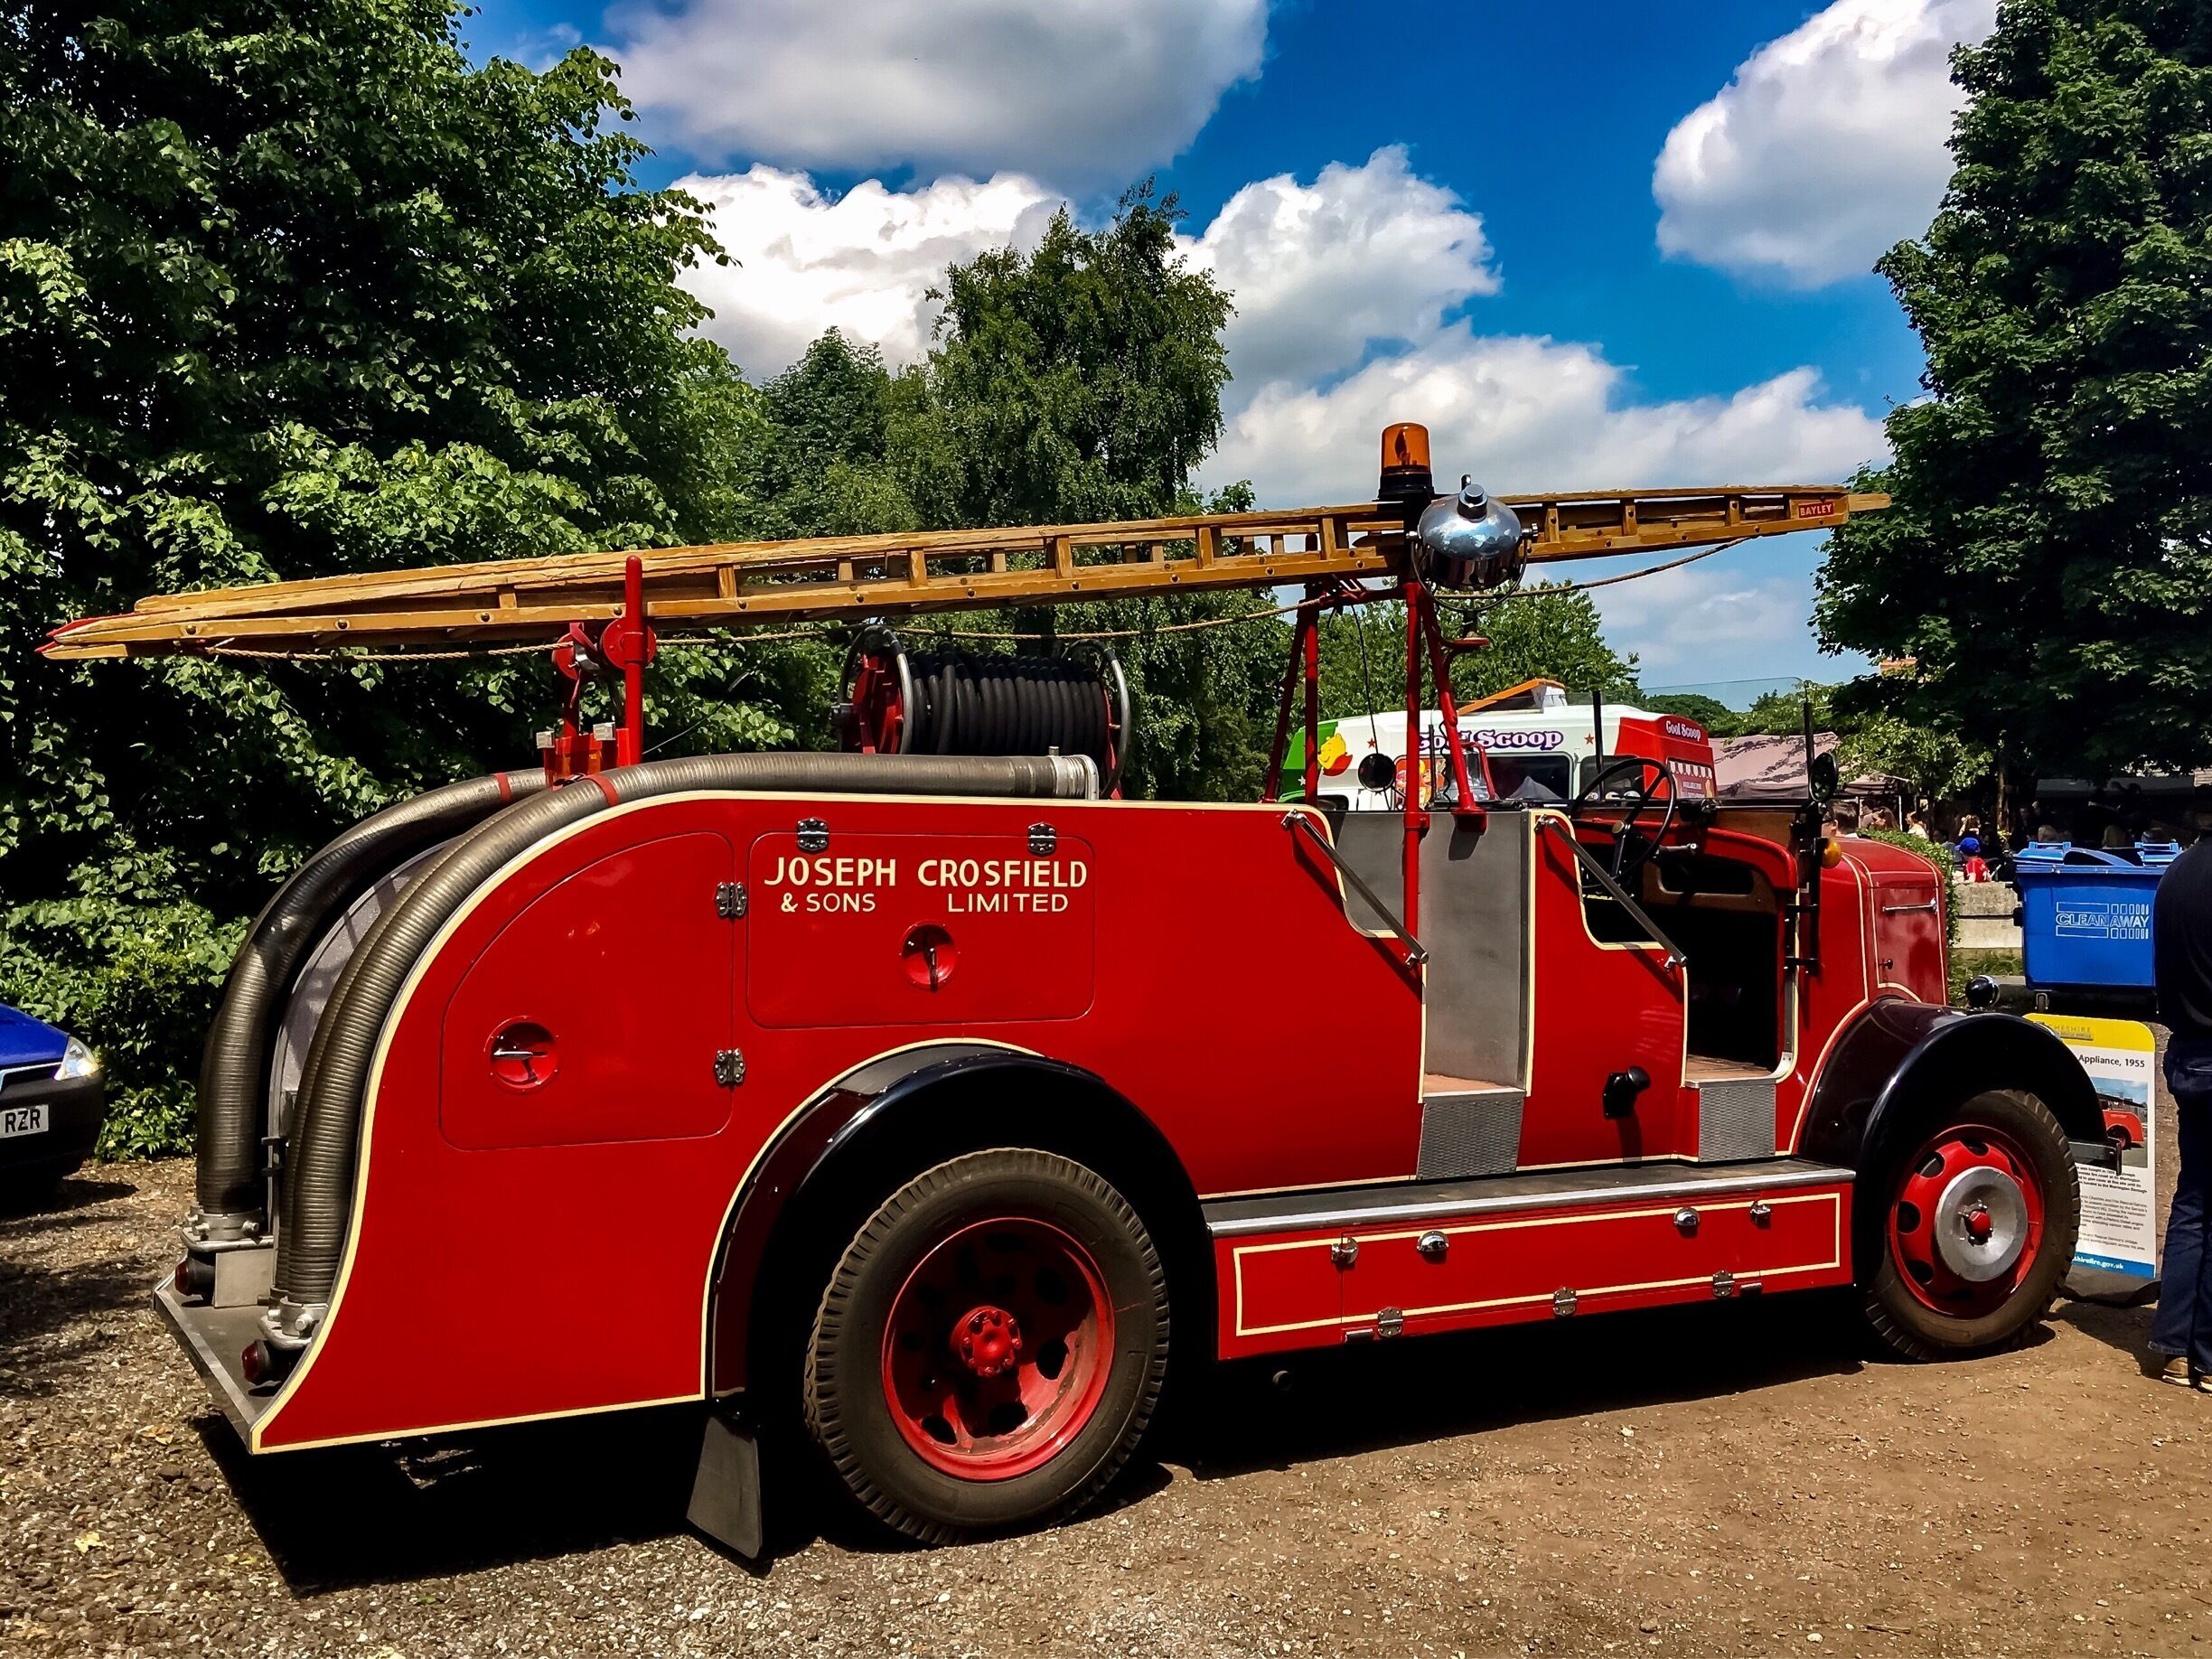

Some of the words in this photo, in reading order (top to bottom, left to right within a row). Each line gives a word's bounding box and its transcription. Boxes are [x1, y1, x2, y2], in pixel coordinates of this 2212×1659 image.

[1800, 504, 1832, 516] BAYLEY
[1474, 729, 1564, 751] Scoop
[764, 857, 896, 887] JOSEPH
[917, 859, 1088, 888] CROSFIELD
[780, 893, 799, 913] &
[806, 893, 876, 913] SONS
[947, 893, 1069, 913] LIMITED
[2078, 1054, 2122, 1066] Appliance,
[2124, 1058, 2145, 1068] 1955
[5, 1109, 41, 1133] RZR
